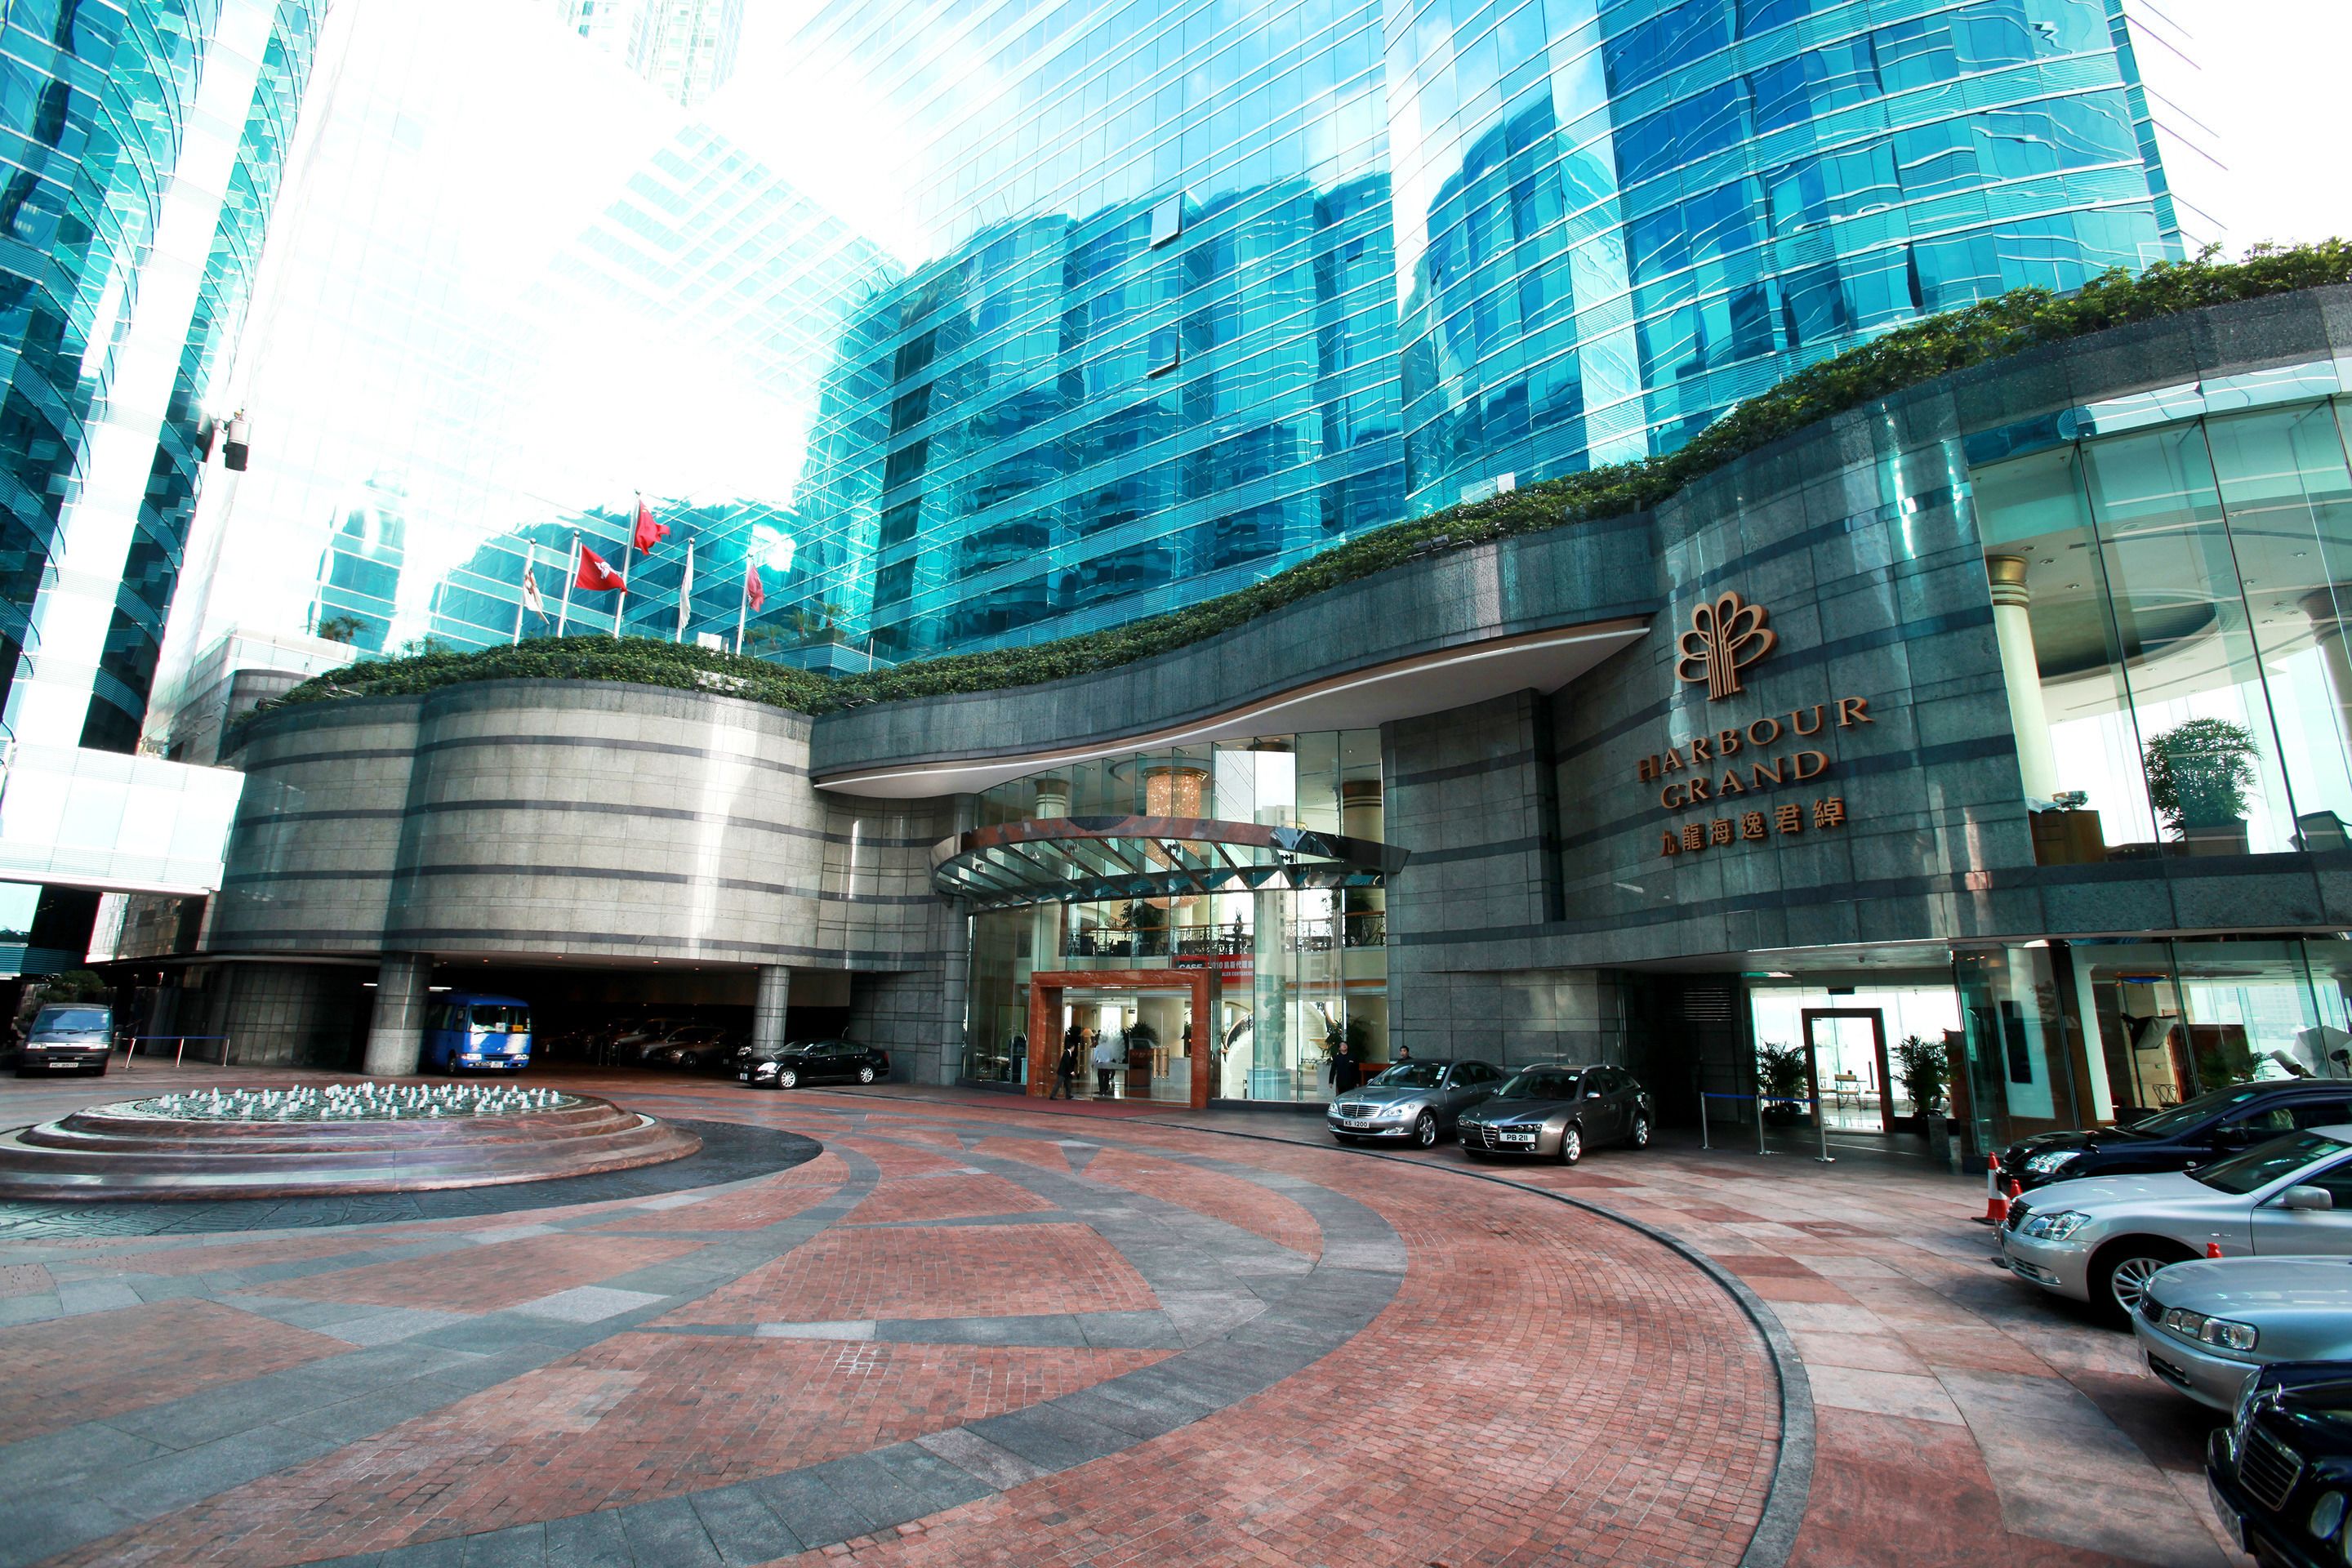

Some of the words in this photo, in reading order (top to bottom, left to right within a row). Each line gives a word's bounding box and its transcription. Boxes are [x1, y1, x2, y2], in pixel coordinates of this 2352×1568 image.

[1637, 696, 1875, 782] HARBOUR
[1660, 750, 1829, 809] GRAND
[1659, 796, 1846, 857] 九龍海逸君綽
